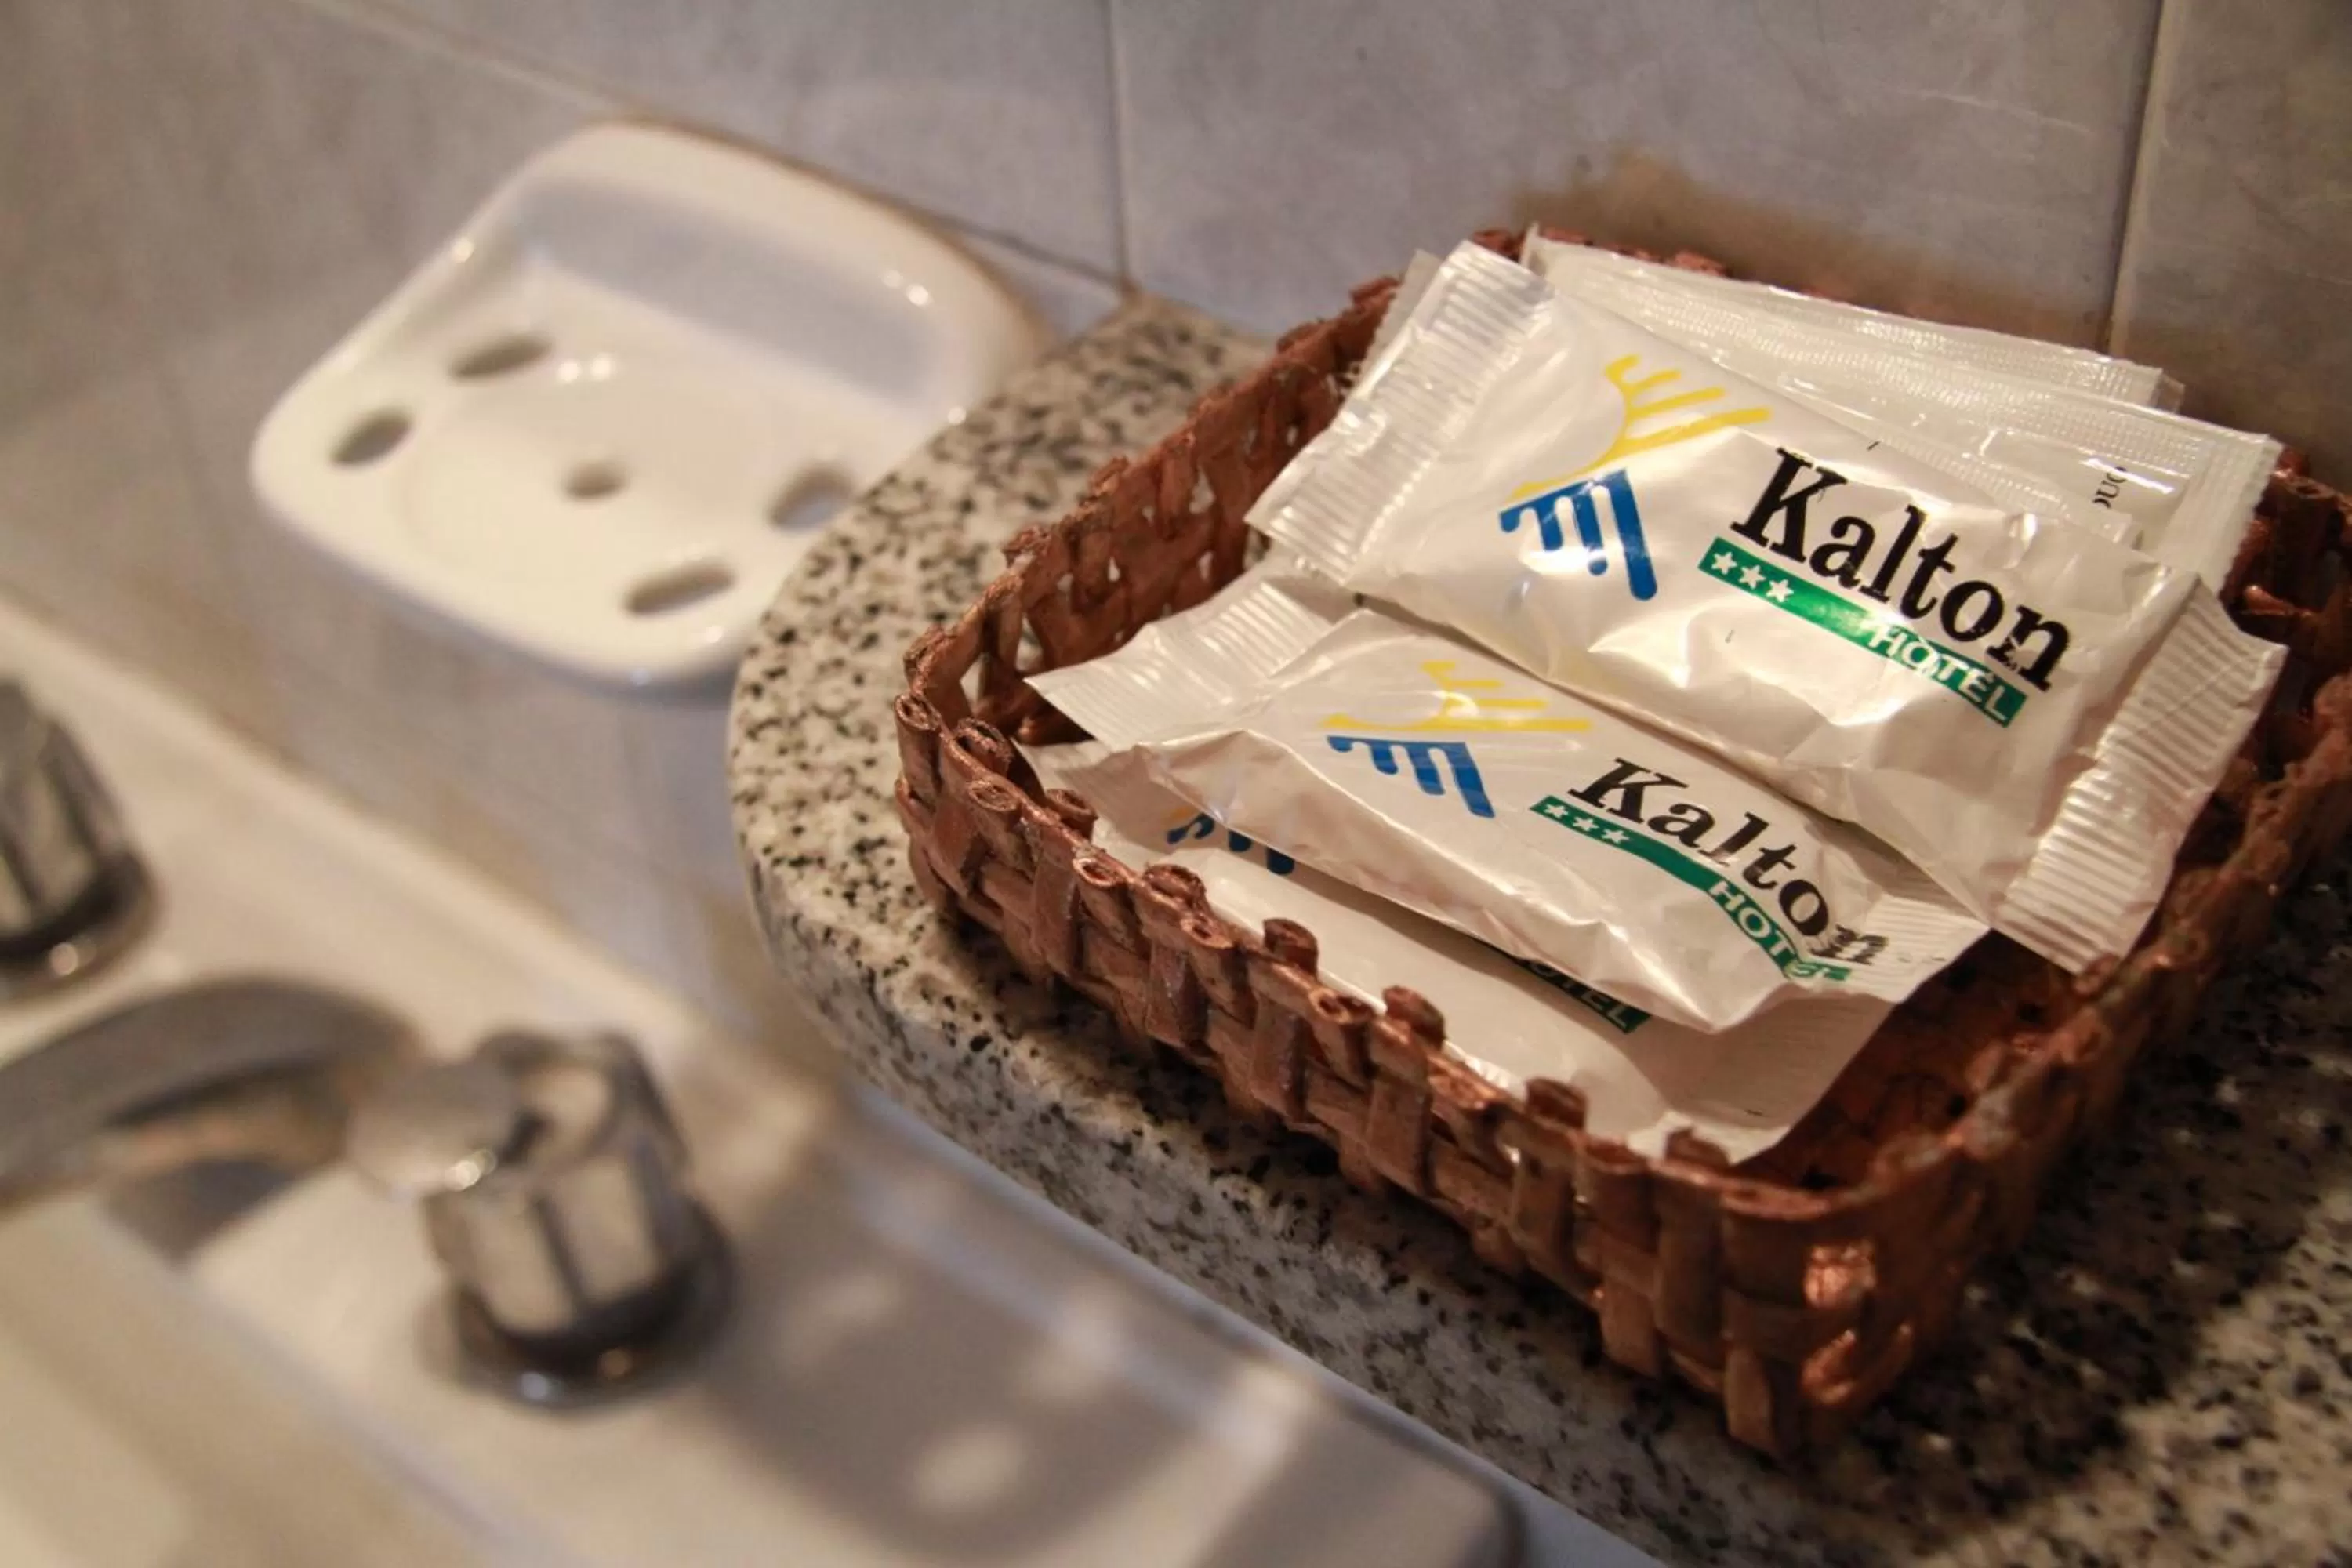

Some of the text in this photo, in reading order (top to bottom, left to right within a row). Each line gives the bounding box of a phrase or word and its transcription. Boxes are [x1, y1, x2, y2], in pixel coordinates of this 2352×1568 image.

[1730, 446, 2071, 693] Kalton
[1868, 622, 2008, 722] HOTEL
[1568, 757, 1889, 966] Kalton
